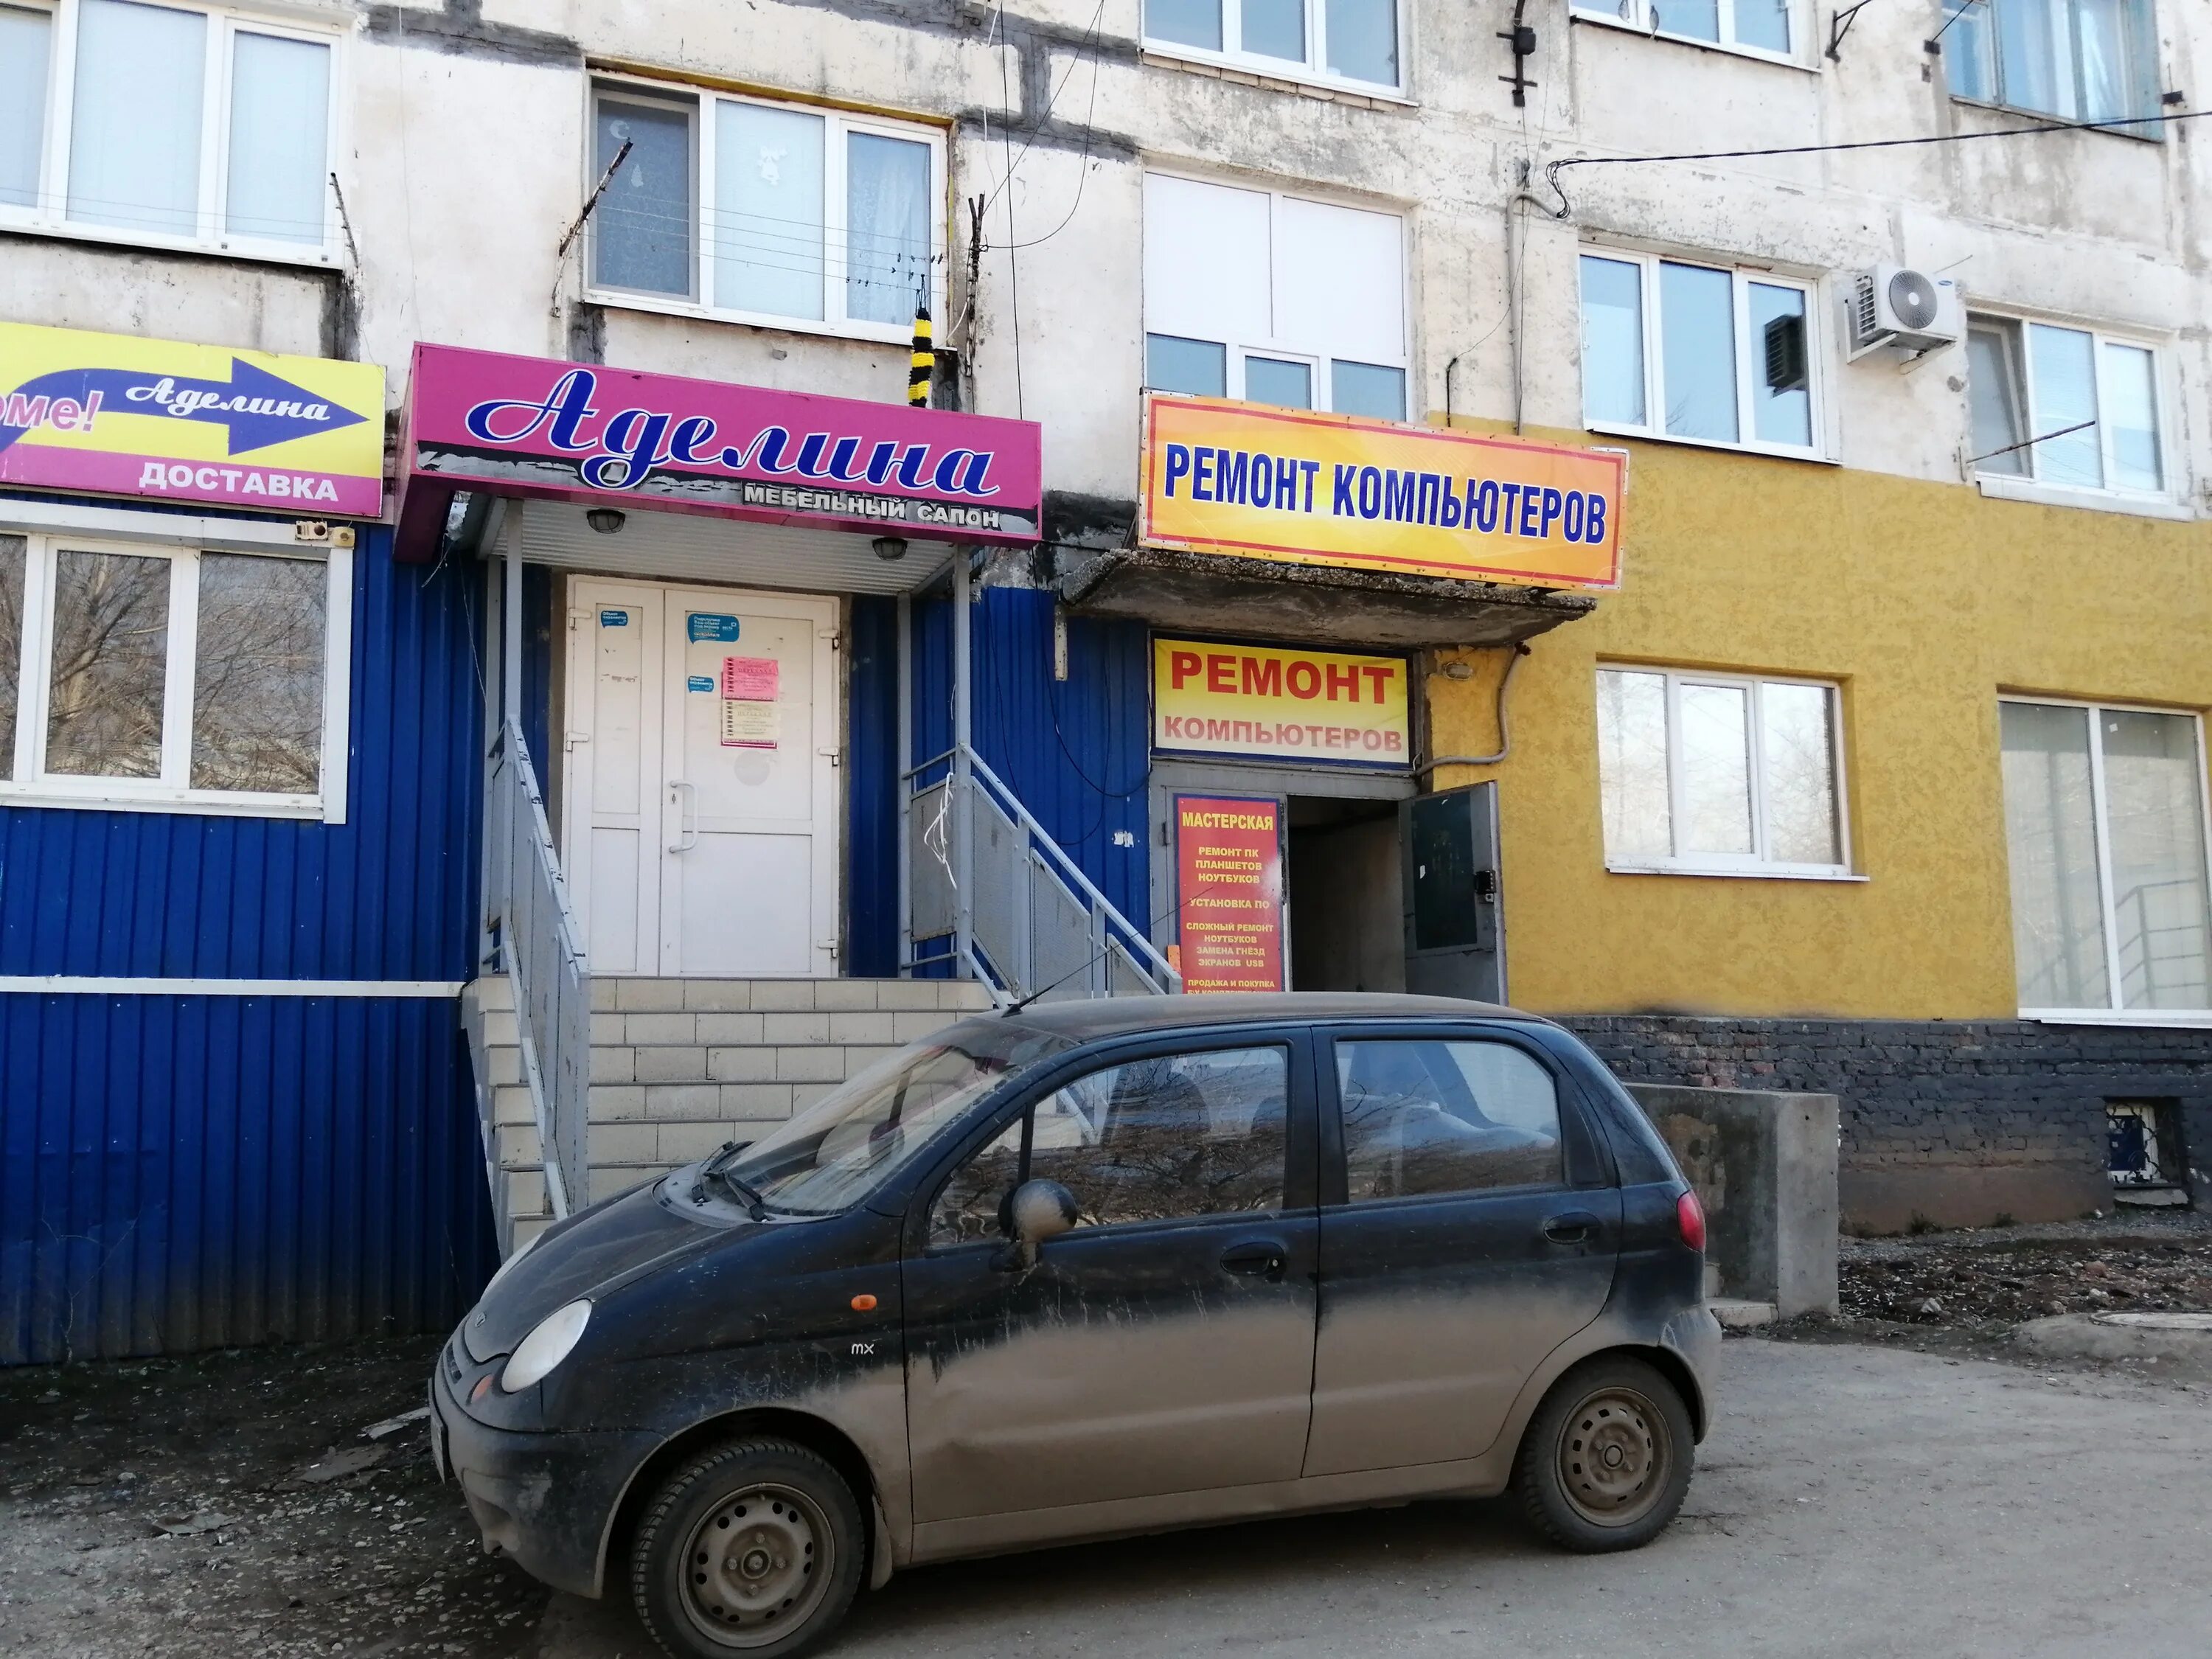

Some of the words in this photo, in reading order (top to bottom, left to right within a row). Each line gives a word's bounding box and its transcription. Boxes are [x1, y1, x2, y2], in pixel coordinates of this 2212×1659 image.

[125, 378, 330, 420] Аделина
[465, 369, 1001, 497] Аделина
[139, 462, 338, 501] ДОСТАВКА
[1164, 442, 1320, 513] РЕМОНТ
[1332, 463, 1608, 546] КОМПЬЮТЕРОВ
[745, 484, 905, 518] МЕБЕЛЬНЫЙ
[917, 505, 999, 528] САЛОН
[1172, 651, 1394, 704] РЕМОНТ
[1164, 716, 1402, 752] КОМПЬЮТЕРОВ
[1182, 812, 1273, 830] МАСТЕРСКАЯ
[1198, 846, 1242, 857] РЕМОНТ
[1245, 849, 1259, 858] ПК
[1195, 860, 1262, 871] ПЛАНШЕТОВ
[1198, 873, 1260, 883] НОУТБУКОВ
[1190, 898, 1253, 908] УСТАНОВКА
[1255, 900, 1270, 909] ПО
[1186, 922, 1234, 931] СЛОЖНЫЙ
[1237, 924, 1273, 932] РЕМОНТ
[1204, 935, 1257, 944] НОУТБУКОВ
[1197, 947, 1234, 956] ЗАМЕНА
[1188, 979, 1228, 987] ПРОДАЖА
[851, 1343, 874, 1354] mx
